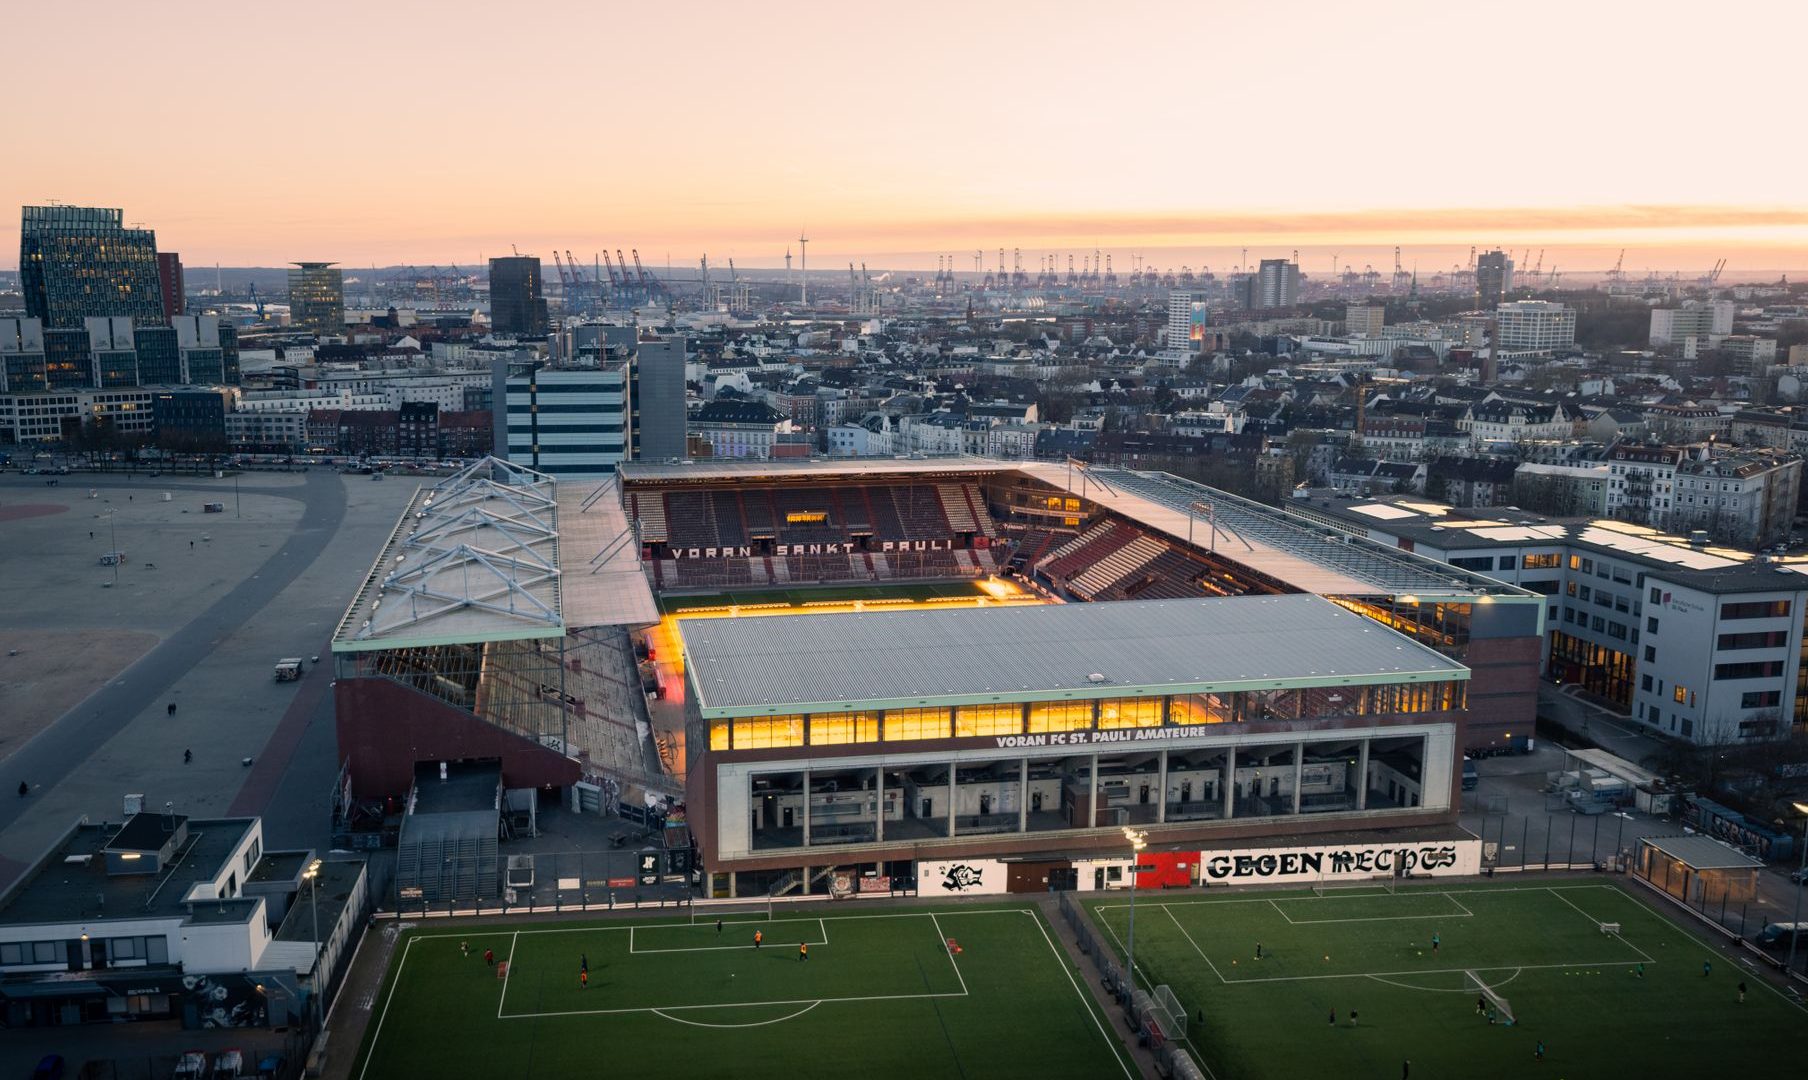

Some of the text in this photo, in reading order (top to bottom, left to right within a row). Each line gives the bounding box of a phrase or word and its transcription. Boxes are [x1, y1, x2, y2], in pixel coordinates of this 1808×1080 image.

[672, 540, 952, 559] VORAN SANKT PAULI
[996, 726, 1206, 748] VORAN FC ST. PAULI AMATEURE
[1207, 845, 1457, 879] GEGEN RECHTS
